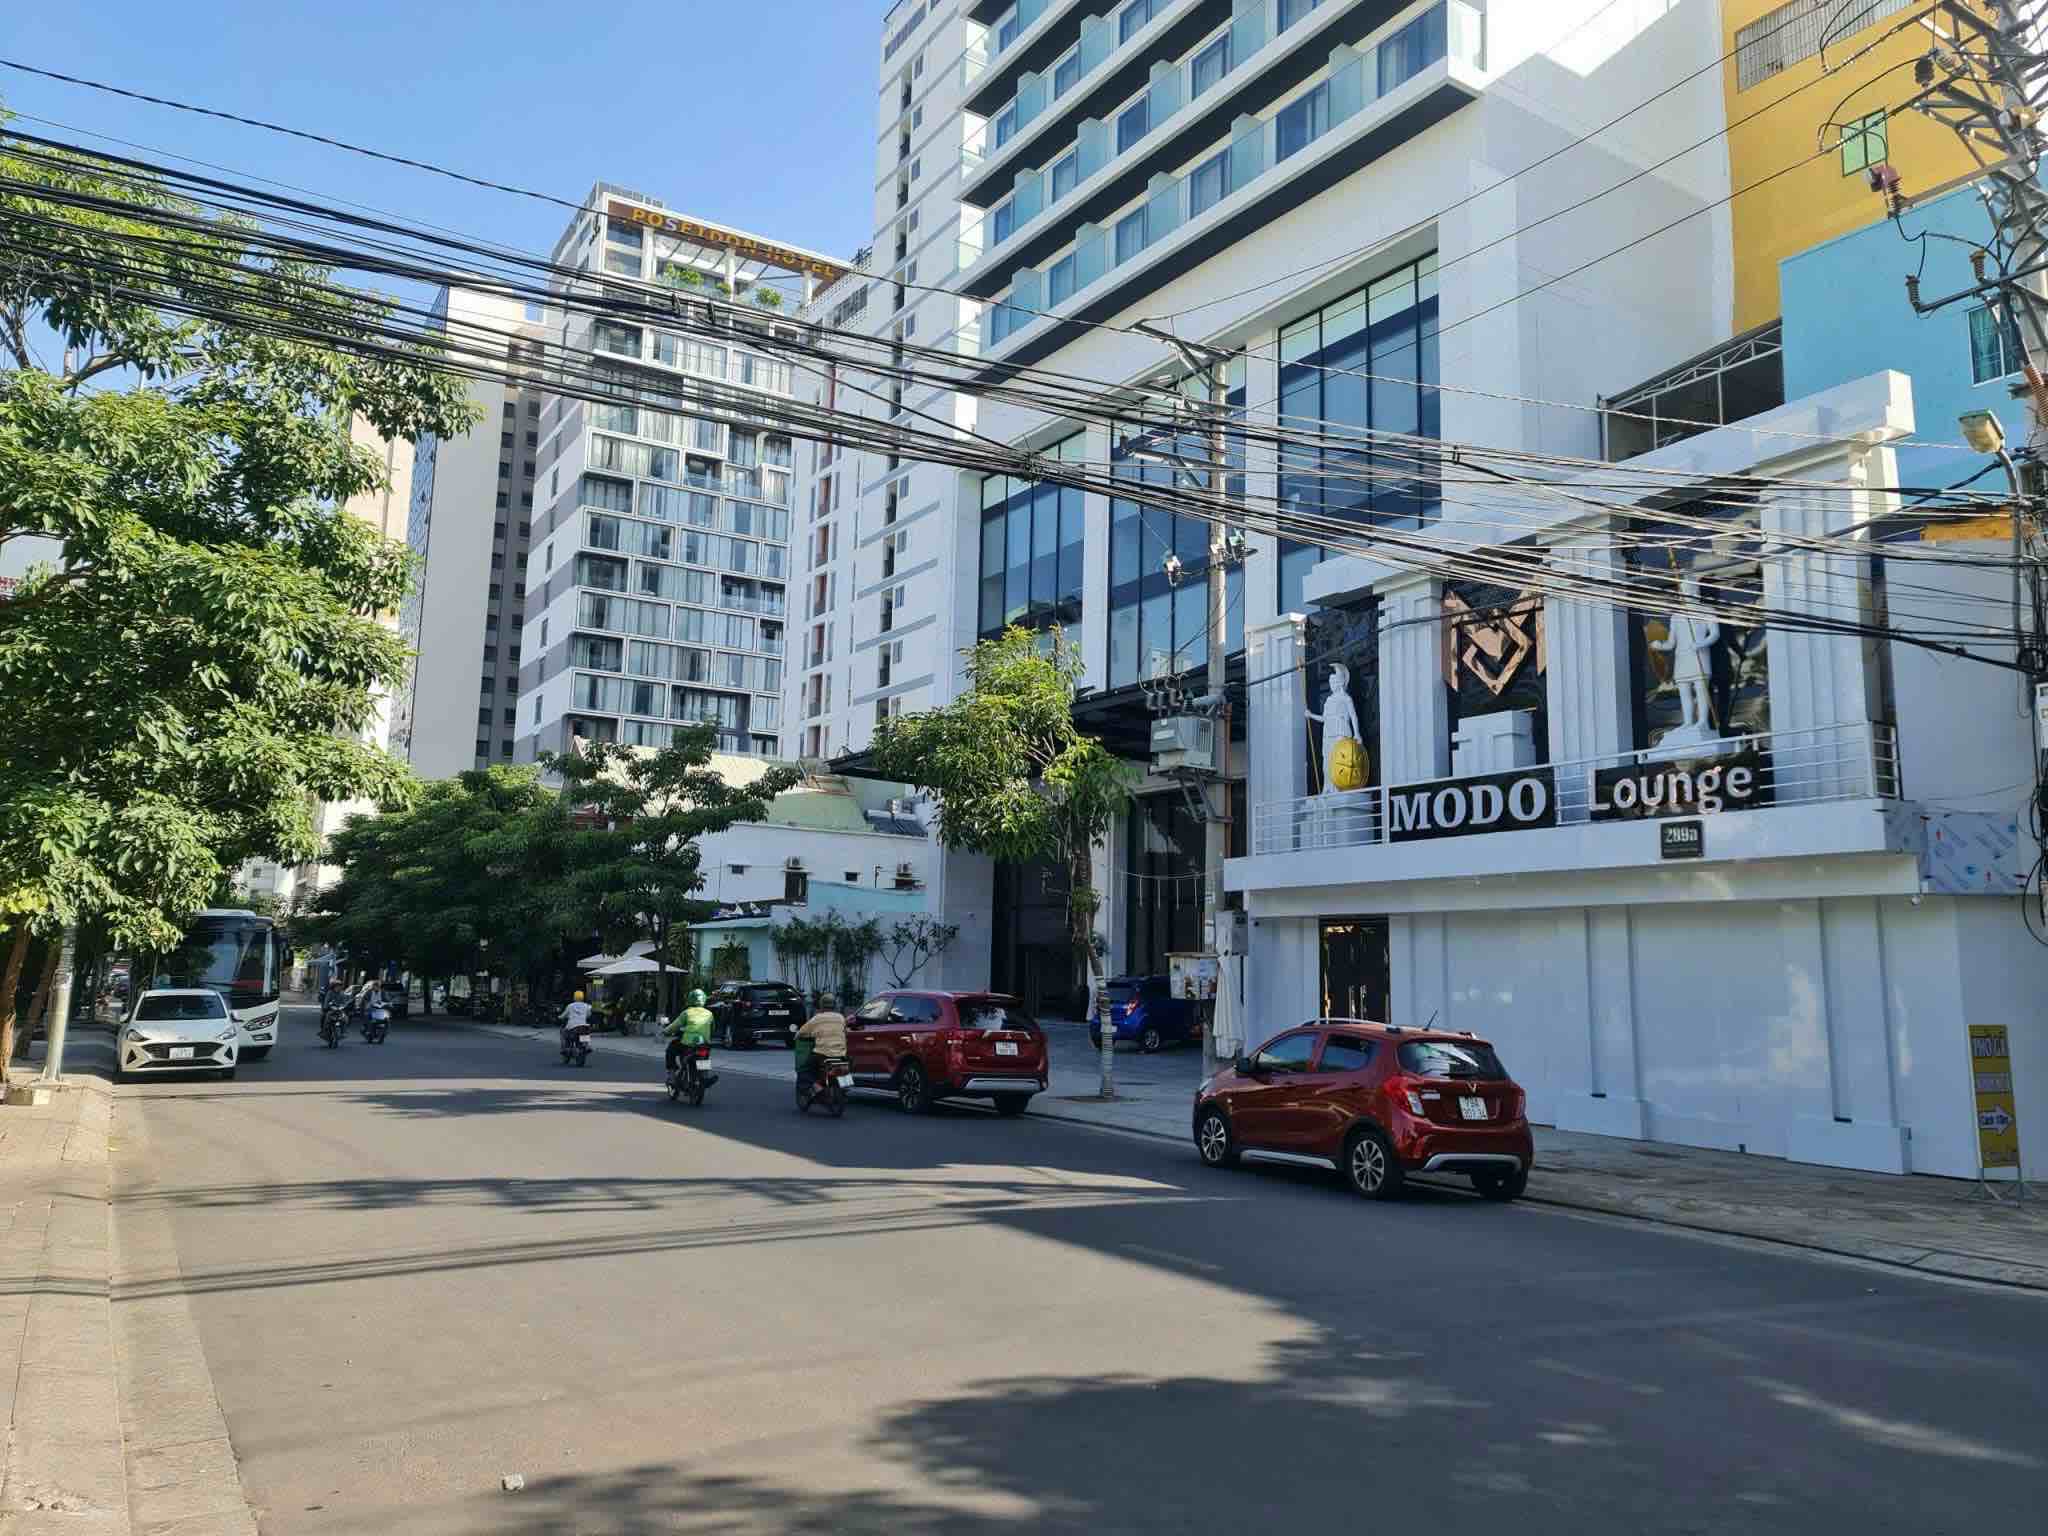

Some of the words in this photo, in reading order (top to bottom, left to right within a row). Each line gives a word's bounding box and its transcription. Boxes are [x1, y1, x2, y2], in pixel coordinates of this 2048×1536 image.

[631, 207, 758, 257] POSEIDON
[767, 246, 835, 278] HOTEL
[1390, 777, 1546, 832] MODO
[1589, 766, 1753, 815] Lounge
